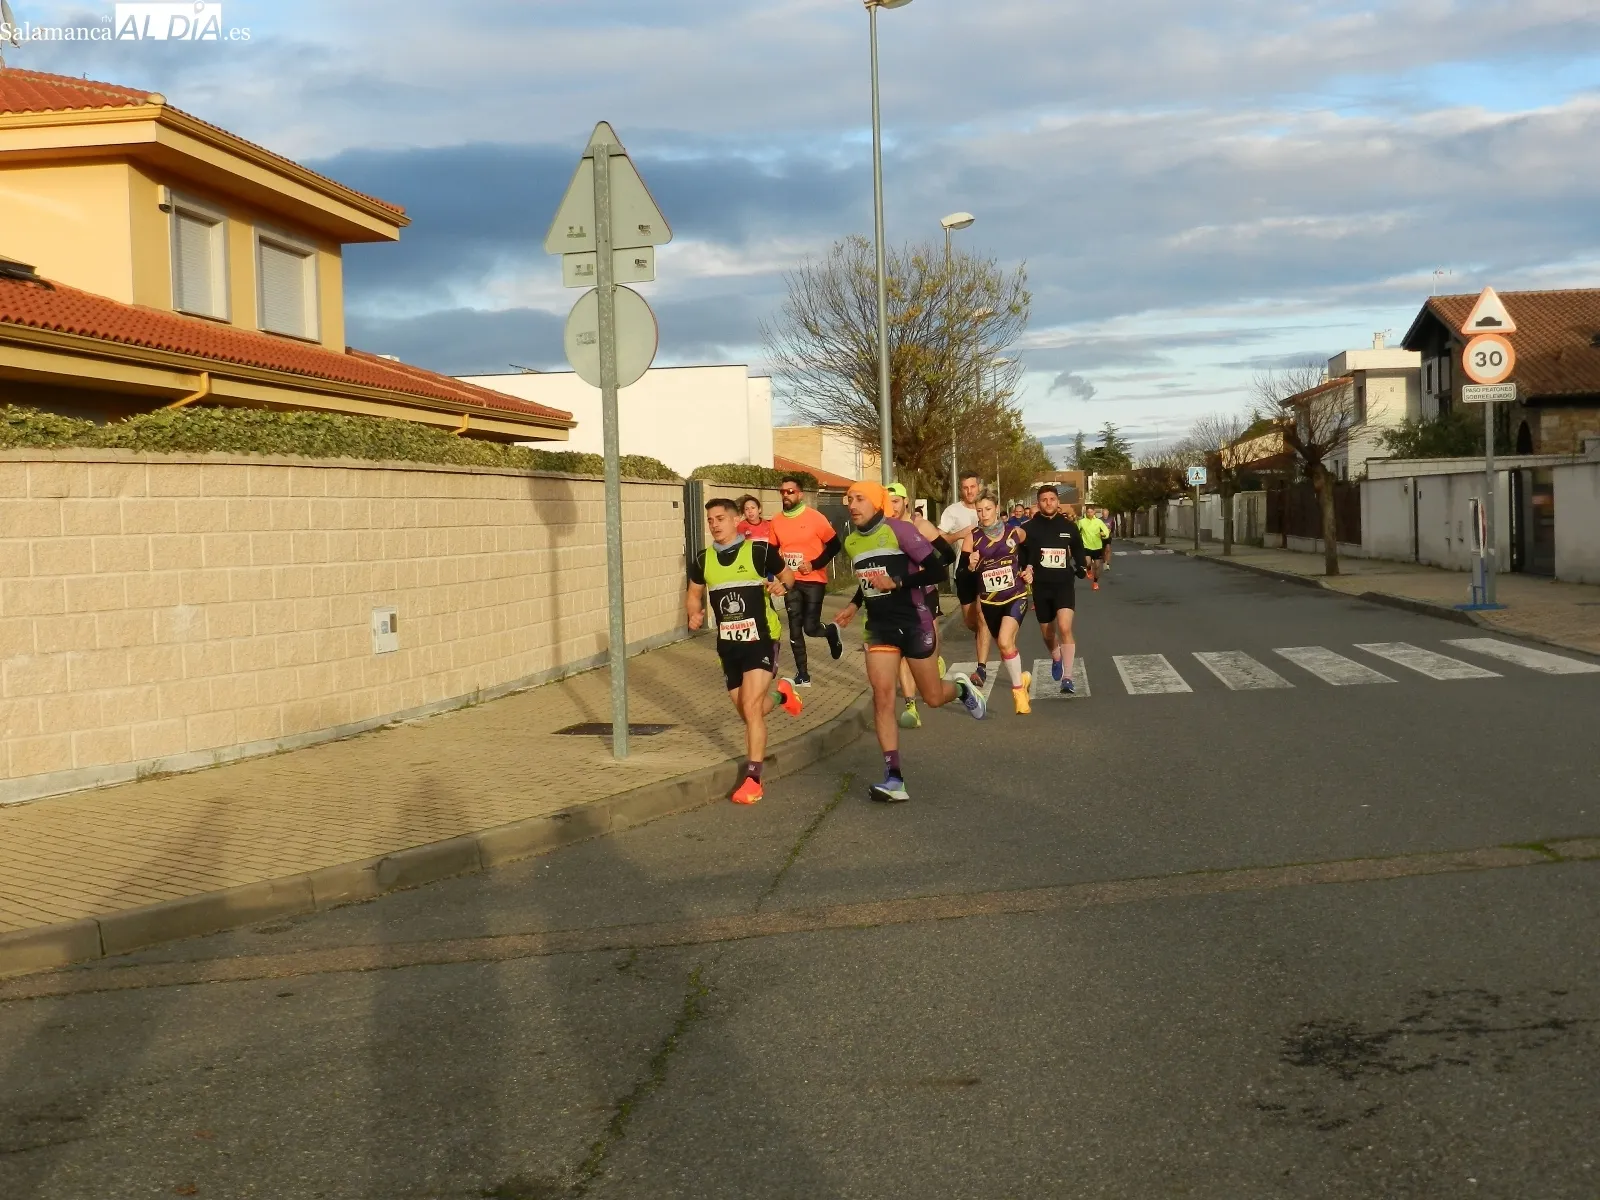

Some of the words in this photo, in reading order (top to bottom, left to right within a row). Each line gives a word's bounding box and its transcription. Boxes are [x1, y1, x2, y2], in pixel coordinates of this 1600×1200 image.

[1475, 351, 1502, 367] 30
[861, 578, 874, 590] 24
[989, 574, 1009, 587] 192
[727, 628, 750, 641] 167
